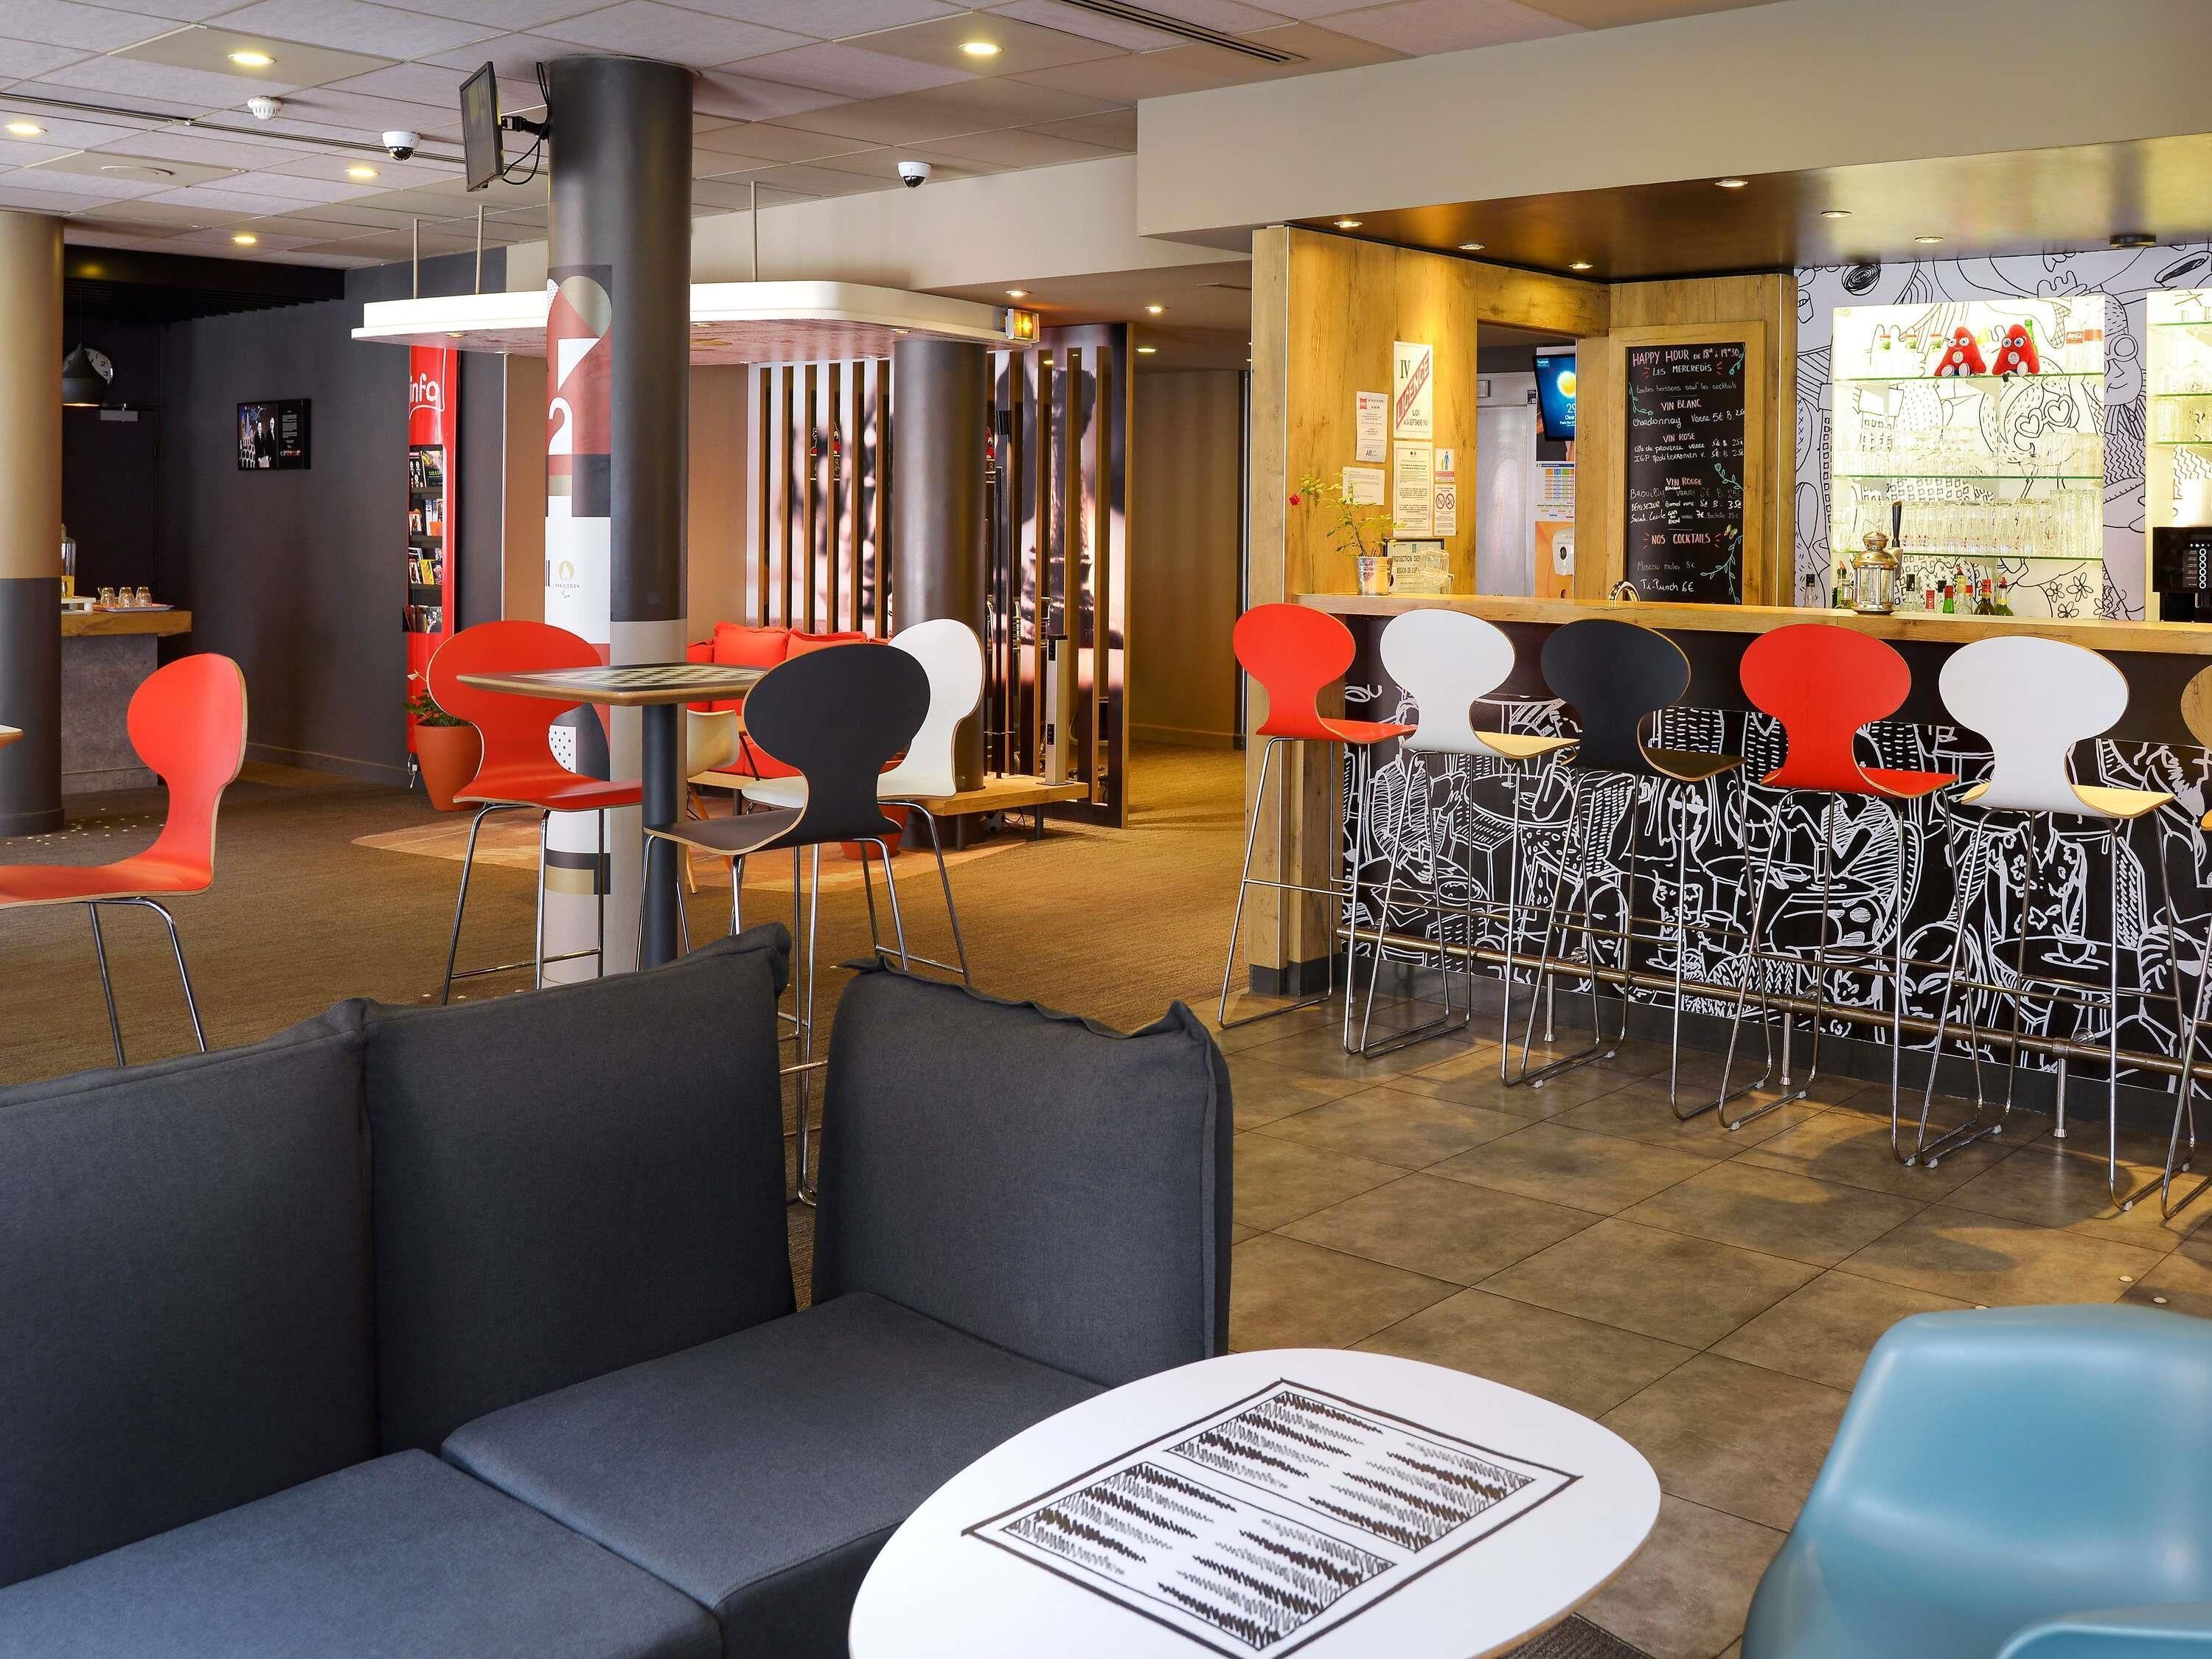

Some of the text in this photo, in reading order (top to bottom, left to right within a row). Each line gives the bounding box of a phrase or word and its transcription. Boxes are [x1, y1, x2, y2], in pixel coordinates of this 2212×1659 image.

[1632, 350, 1660, 367] HAPPY
[1665, 349, 1690, 363] HOUR
[1399, 359, 1411, 379] IV
[1652, 367, 1666, 376] LES
[1685, 382, 1699, 391] sauf
[1712, 380, 1736, 389] cocktails
[1660, 399, 1703, 411] VIN BLANC
[1663, 434, 1675, 443] VIN
[1634, 454, 1650, 462] IGP
[1666, 477, 1703, 486] VIN ROUGE
[1651, 533, 1711, 545] NOS COCKTAILS
[1639, 579, 1694, 592] Ti-Punch 6€
